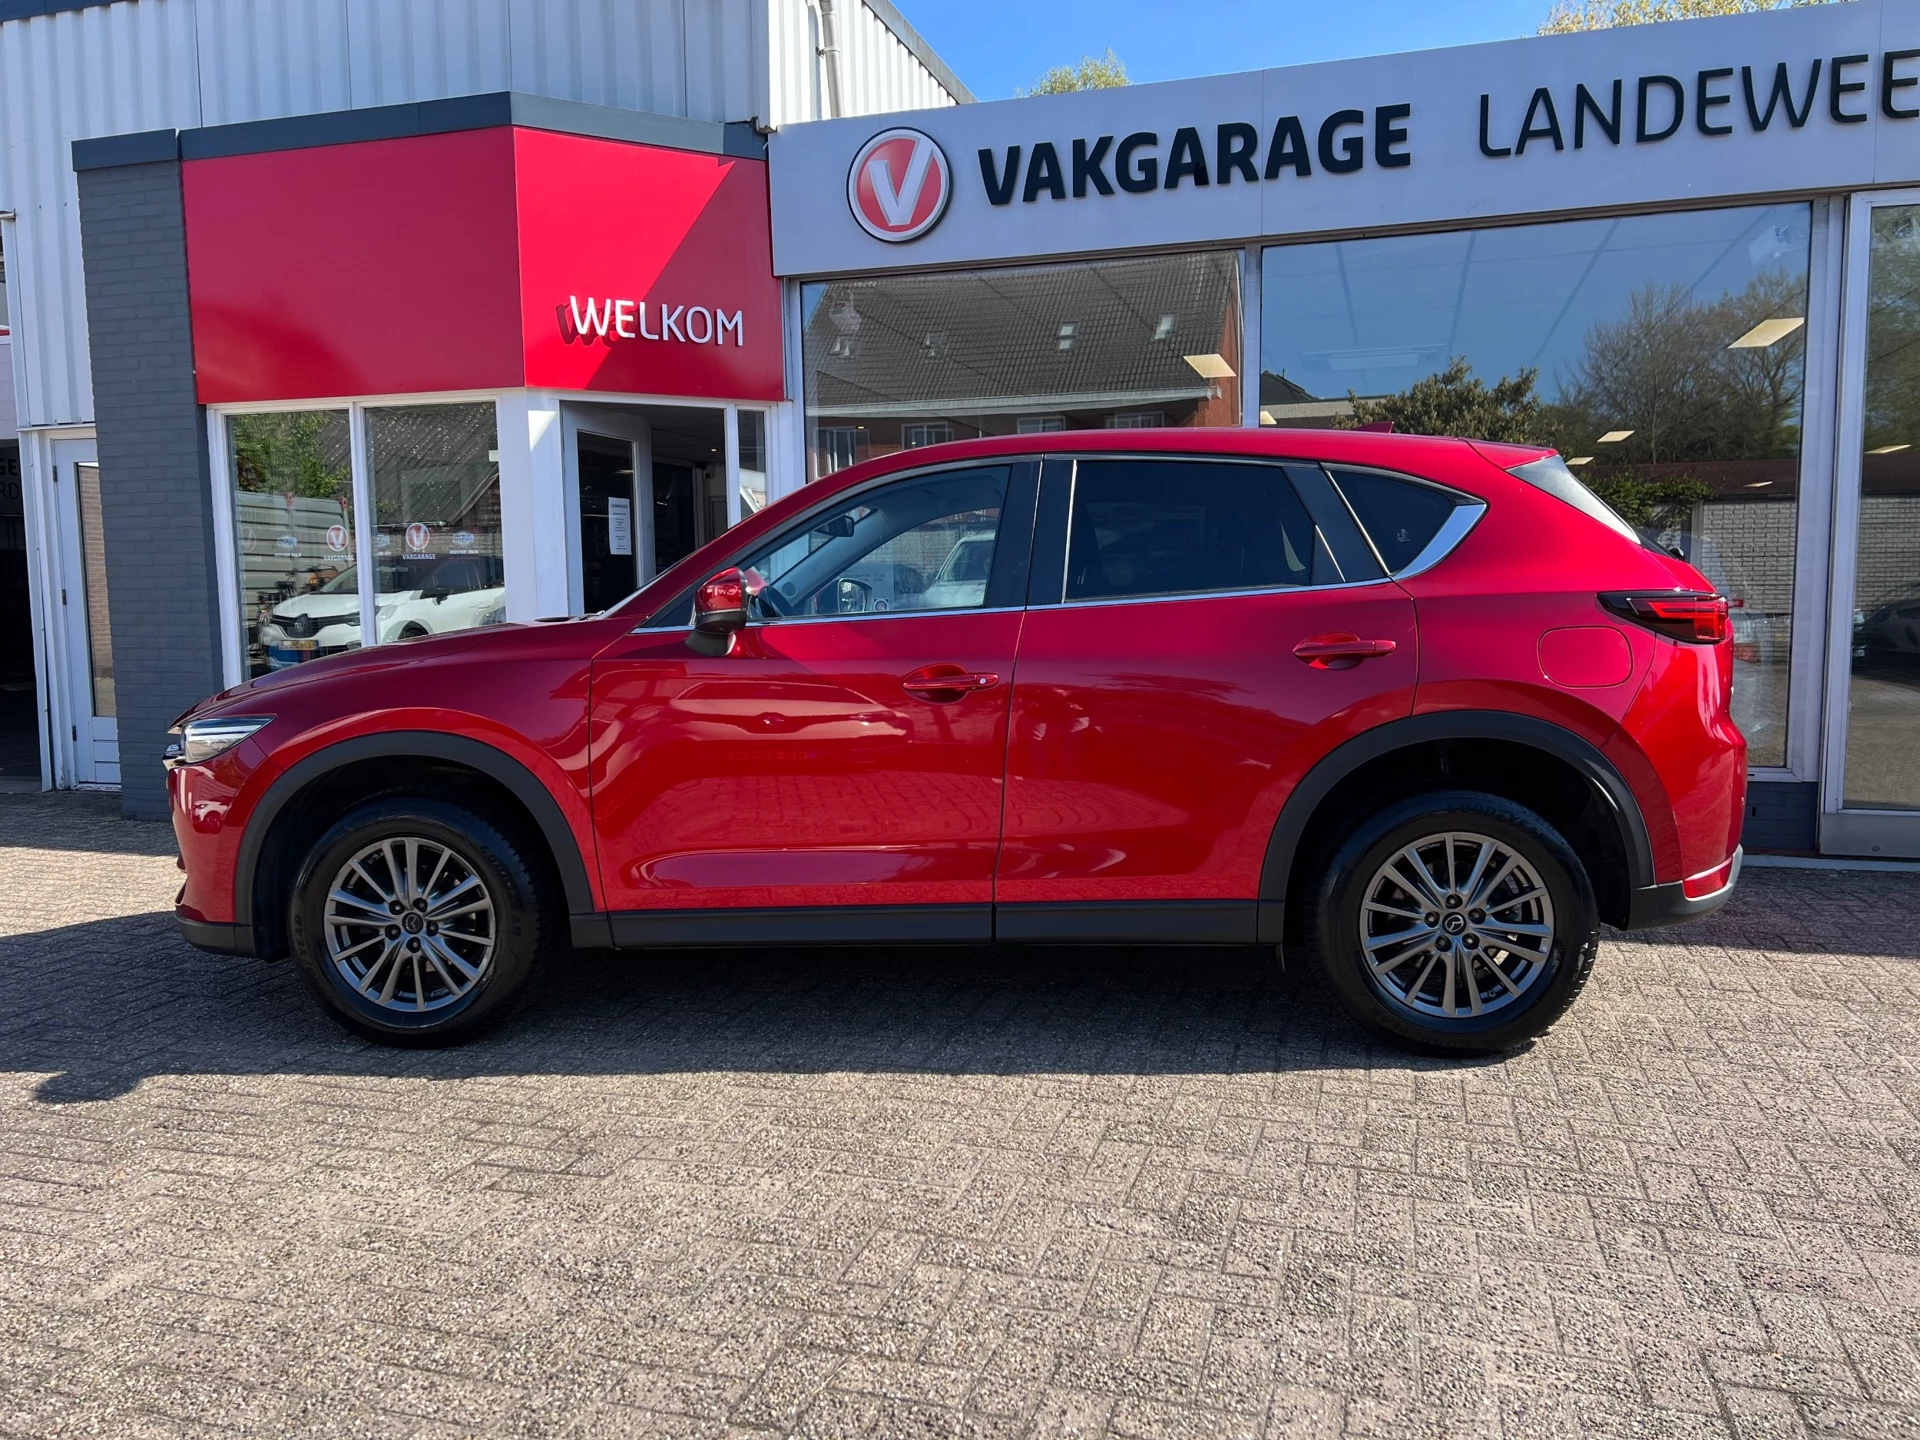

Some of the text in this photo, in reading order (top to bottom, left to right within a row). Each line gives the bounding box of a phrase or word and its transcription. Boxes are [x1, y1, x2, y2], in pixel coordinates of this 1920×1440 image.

[977, 48, 1920, 206] VAKGARAGE LANDEWEE
[868, 140, 936, 226] V
[569, 295, 744, 347] WELKOM
